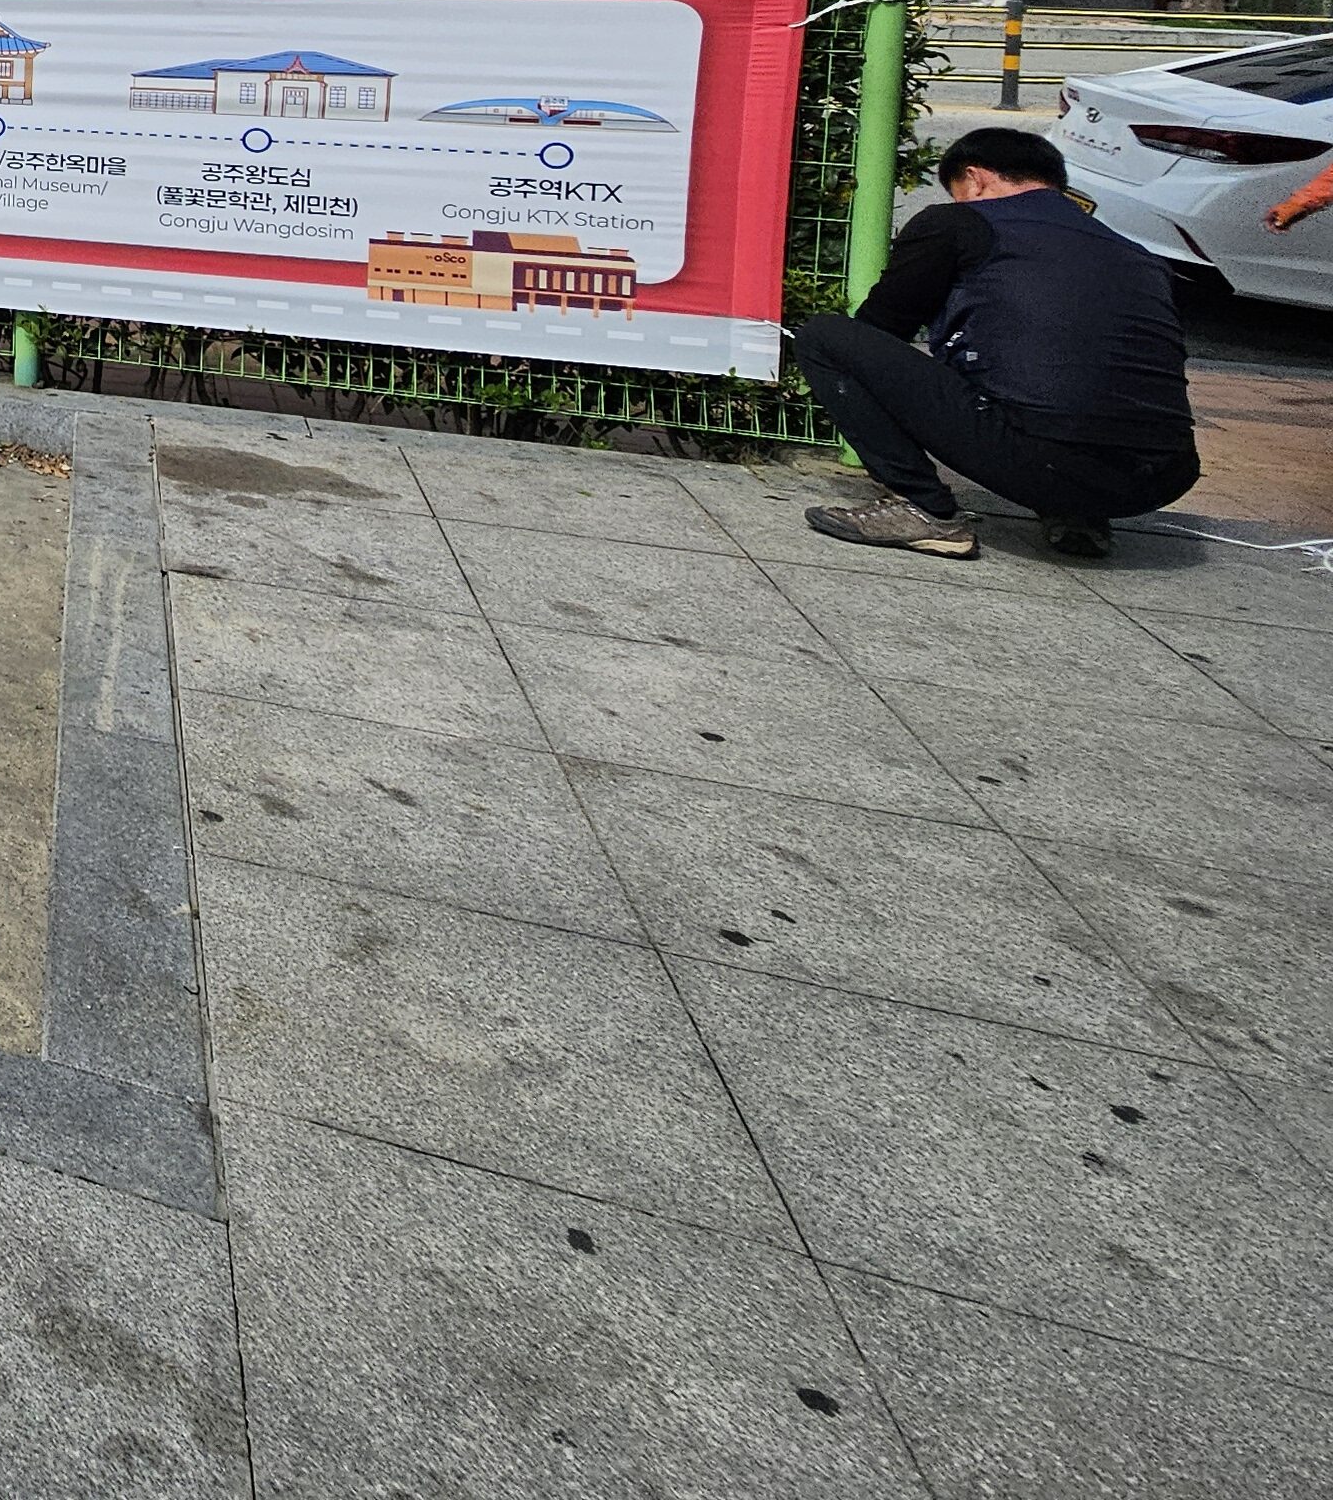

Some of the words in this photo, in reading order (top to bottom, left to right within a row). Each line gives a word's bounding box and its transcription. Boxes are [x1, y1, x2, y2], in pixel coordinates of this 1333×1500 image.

[22, 177, 109, 196] Museum/
[201, 162, 312, 188] 공주왕도심
[156, 185, 277, 216] (풀꽃문학관,
[283, 194, 359, 218] 제민천)
[489, 176, 623, 203] 공주역KTX
[159, 213, 229, 234] Gongju
[233, 217, 354, 240] Wangdosim
[442, 203, 520, 225] Gongju
[527, 209, 569, 226] KTX
[574, 212, 654, 231] Station
